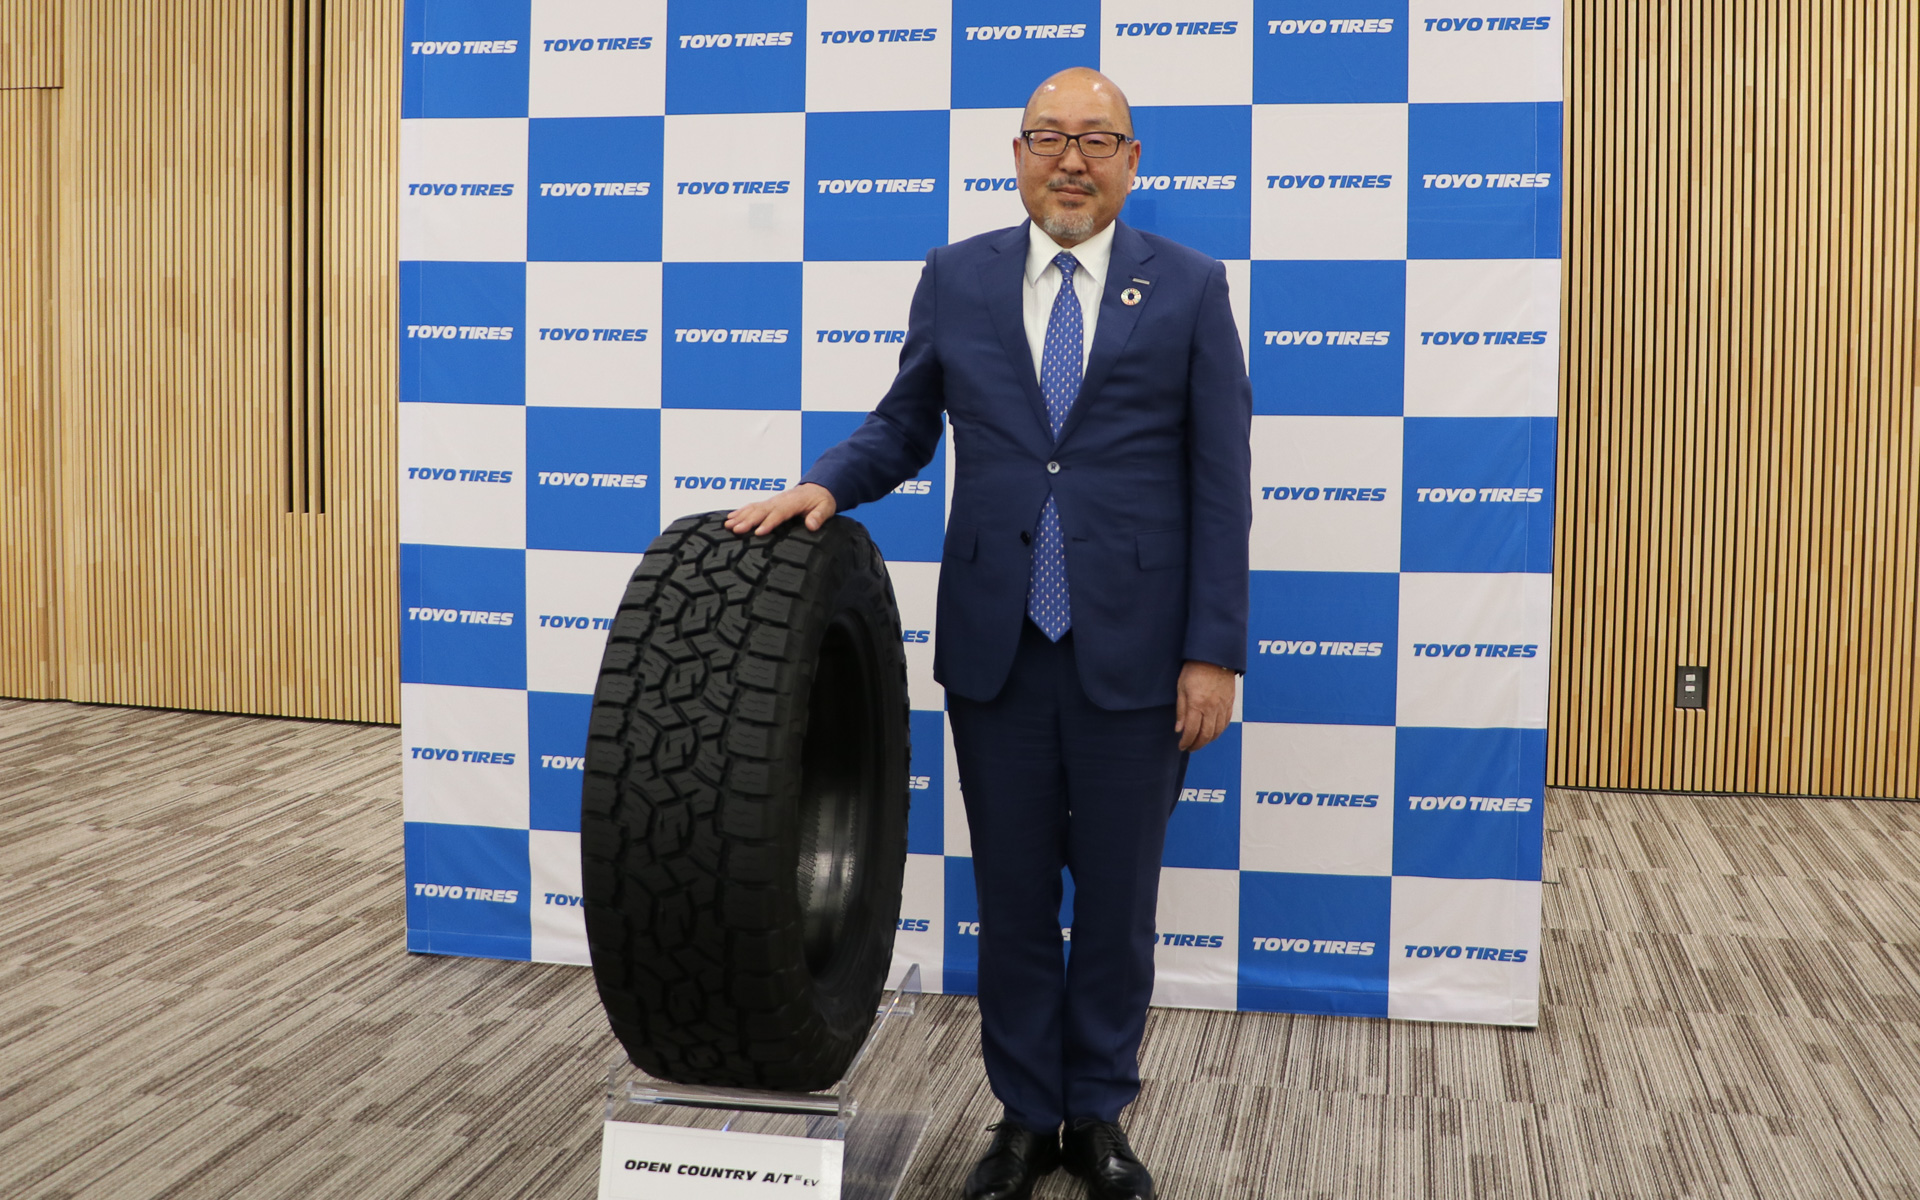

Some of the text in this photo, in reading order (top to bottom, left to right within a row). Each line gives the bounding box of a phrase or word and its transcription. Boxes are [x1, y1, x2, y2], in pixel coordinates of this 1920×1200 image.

[1116, 21, 1238, 36] TOYO TIRES
[1268, 19, 1394, 34] TOYO TIRES
[1424, 17, 1551, 31] TOYO TIRES
[821, 28, 937, 44] TOYO TIRES
[966, 24, 1086, 40] TOYO TIRES
[411, 40, 518, 55] TOYO TIRES
[544, 37, 653, 52] TOYO TIRES
[679, 32, 793, 48] TOYO TIRES
[677, 181, 790, 195] TOYO TIRES
[818, 178, 935, 193] TOYO TIRES
[963, 178, 1017, 191] TOYO
[1131, 175, 1236, 190] OYO TIRES
[1267, 175, 1392, 189] TOYO TIRES
[1423, 173, 1551, 188] TOYO TIRES
[409, 184, 514, 196] TOYO TIRES
[540, 182, 650, 196] TOYO TIRES
[407, 325, 513, 340] TOYO TIRES
[539, 328, 648, 341] TOYO TIRES
[675, 329, 789, 343] TOYO TIRES
[816, 330, 909, 343] TOYO TIR
[1264, 331, 1390, 345] TOYO TIRES
[1421, 331, 1547, 345] TOYO TIRES
[408, 467, 513, 483] TOYO TIRES
[538, 472, 648, 488] TOYO TIRES
[674, 476, 787, 491] TOYO TIRES
[890, 480, 932, 495] RES
[1262, 487, 1386, 501] TOYO TIRES
[1417, 488, 1543, 503] TOYO TIRES
[408, 607, 514, 626] TOYO TIRES
[539, 615, 589, 629] TOYO
[1258, 640, 1383, 656] TOYO TIRES
[1413, 644, 1538, 658] TOYO TIRES
[411, 747, 515, 765] TOYO TIRES
[1178, 788, 1226, 803] RES
[1256, 791, 1379, 807] TOYO TIRES
[1409, 796, 1532, 812] TOYO TIRES
[414, 883, 518, 903] TOYO TIRES
[1162, 933, 1224, 948] TIRES
[1253, 937, 1375, 955] TOYO TIRES
[1405, 945, 1528, 962] TOYO TIRES
[625, 1159, 672, 1173] OPEN
[677, 1164, 758, 1181] COUNTRY
[762, 1172, 793, 1184] A/T
[803, 1178, 820, 1187] EV
